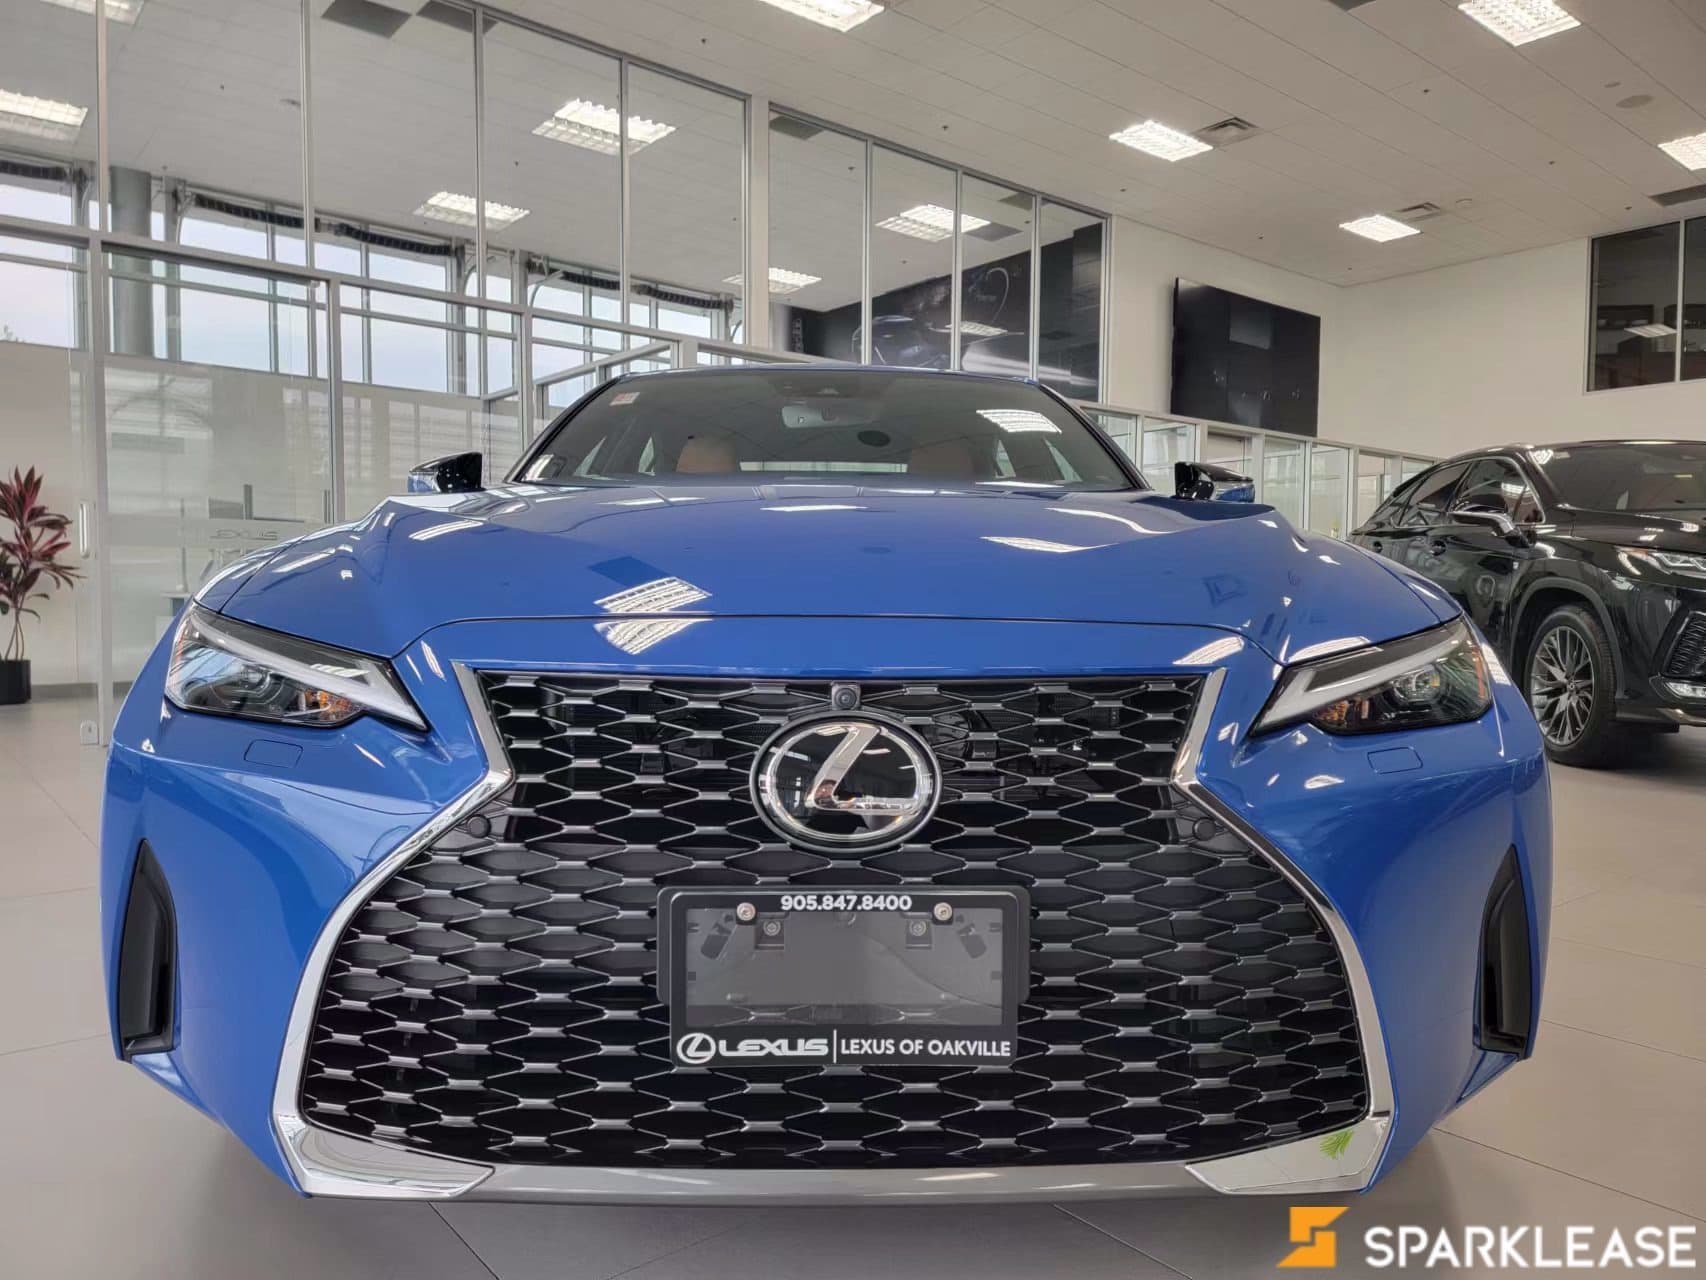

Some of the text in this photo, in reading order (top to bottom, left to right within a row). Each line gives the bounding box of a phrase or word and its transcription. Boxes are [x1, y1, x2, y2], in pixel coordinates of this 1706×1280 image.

[780, 894, 912, 911] 905.847.8400
[718, 1039, 829, 1057] LEXUS
[840, 1039, 1011, 1057] LEXUS OF OAKVILLE
